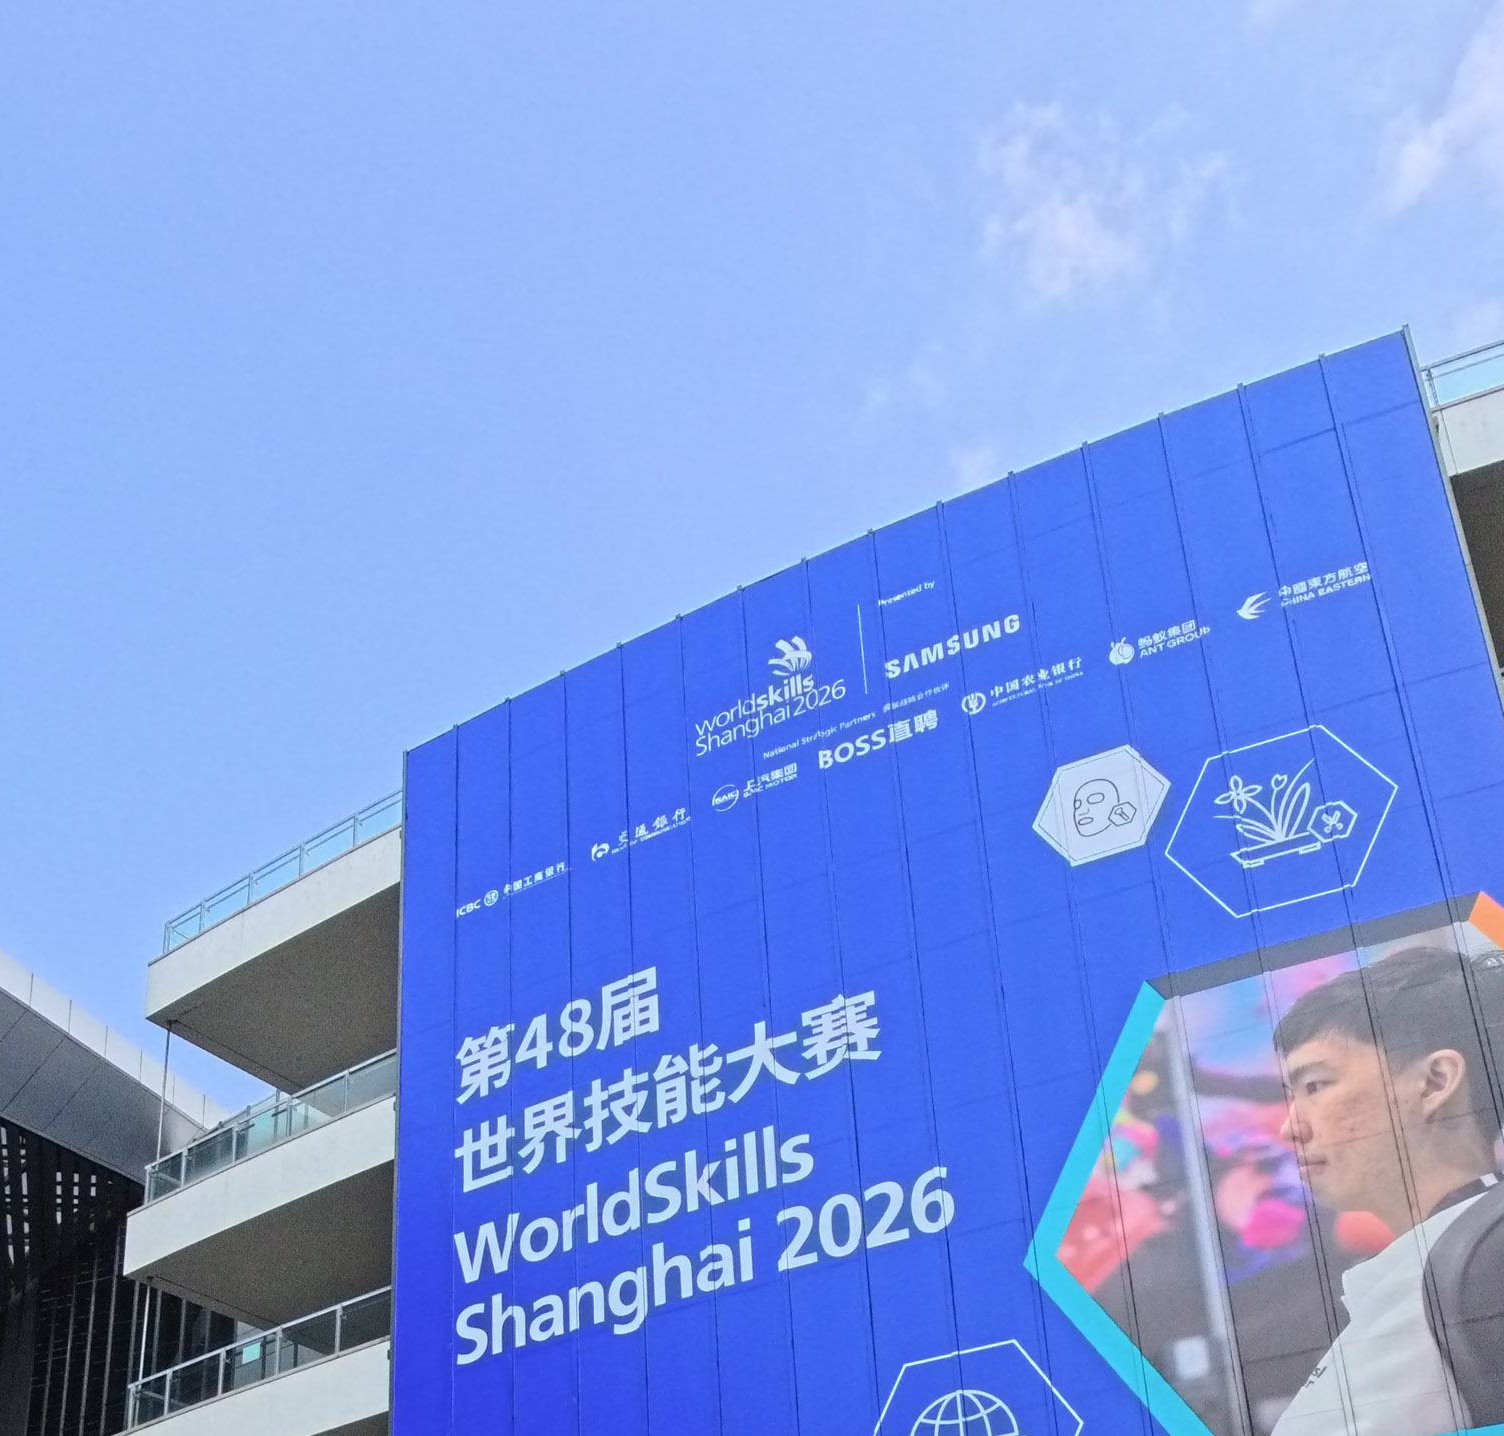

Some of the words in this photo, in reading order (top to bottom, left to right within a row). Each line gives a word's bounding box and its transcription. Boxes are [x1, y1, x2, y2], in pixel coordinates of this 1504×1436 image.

[884, 614, 1022, 679] SAMSUNG
[1140, 642, 1165, 659] ANT
[1166, 626, 1211, 648] GROUP
[695, 673, 814, 736] worldskills
[990, 656, 1082, 698] 中国农业银行
[695, 701, 791, 757] Shanghai
[792, 678, 846, 717] 2026
[762, 739, 800, 761] National
[839, 711, 876, 731] Partners
[817, 708, 939, 770] BOSS直聘
[456, 898, 482, 918] ICBC
[455, 966, 660, 1104] 第48届
[454, 990, 883, 1194] 世界技能大赛
[453, 1125, 815, 1284] WorldSkills
[455, 1217, 754, 1366] Shanghai
[776, 1166, 955, 1273] 2026
